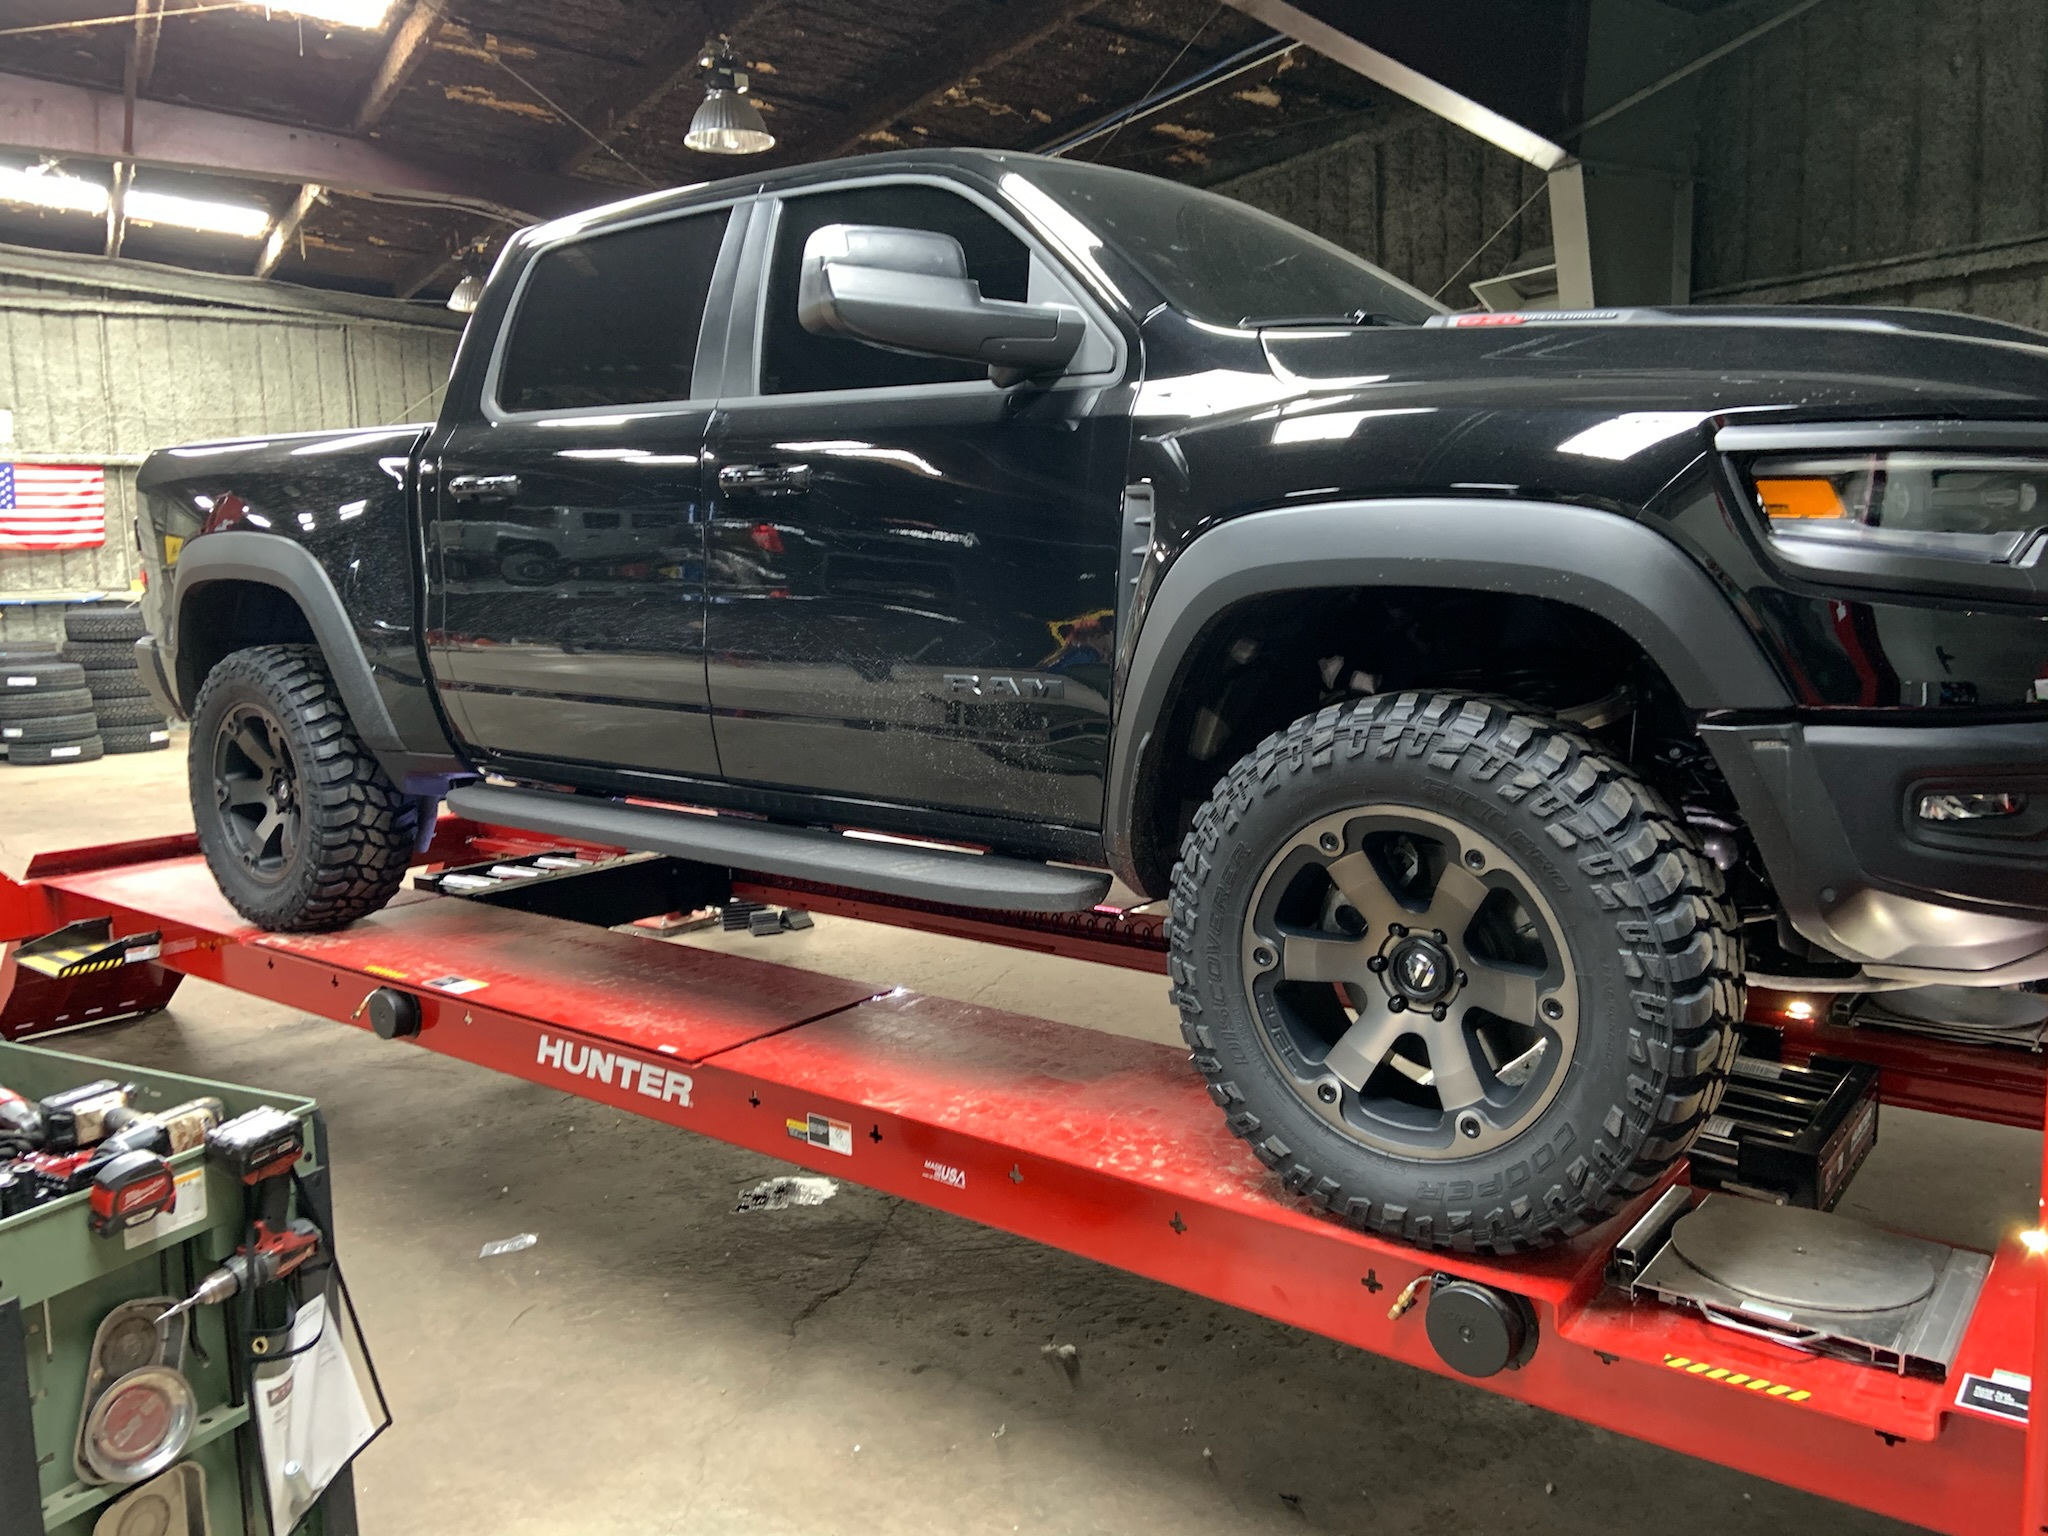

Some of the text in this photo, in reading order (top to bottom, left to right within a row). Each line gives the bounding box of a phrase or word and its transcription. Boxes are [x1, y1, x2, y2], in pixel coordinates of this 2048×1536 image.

[942, 673, 1064, 700] RAM
[1421, 776, 1508, 824] STT
[1207, 840, 1250, 1065] DISCOVERER
[536, 1033, 694, 1108] HUNTER
[941, 1164, 966, 1187] USA
[1415, 1121, 1578, 1201] COOPER
